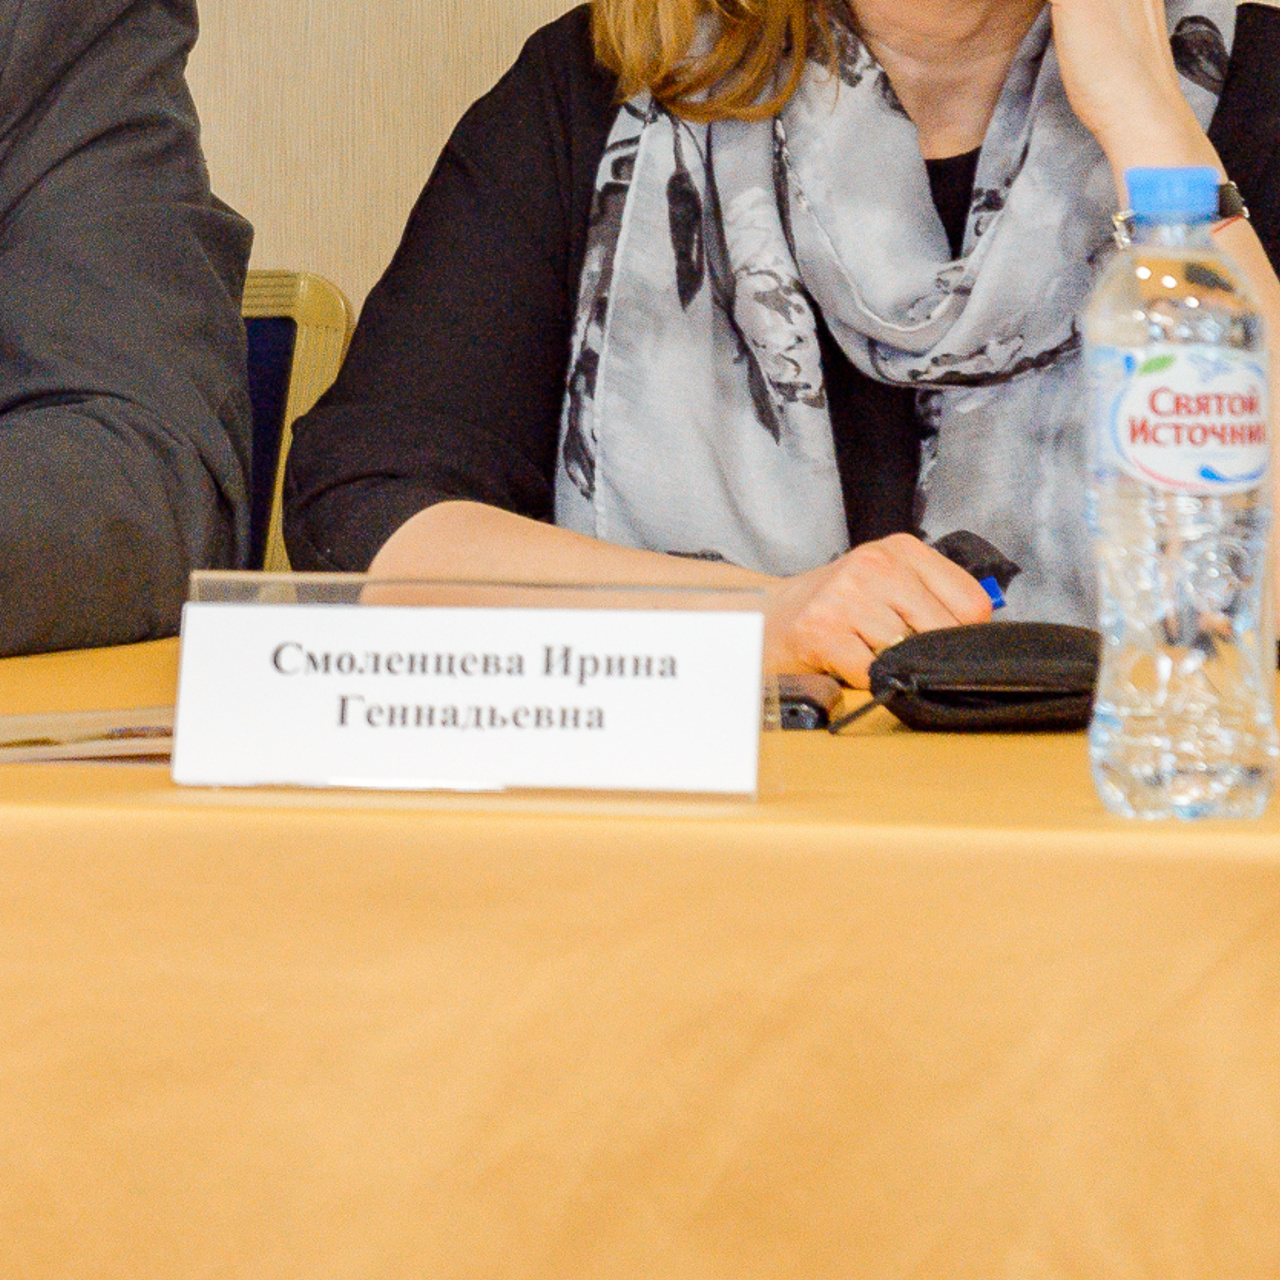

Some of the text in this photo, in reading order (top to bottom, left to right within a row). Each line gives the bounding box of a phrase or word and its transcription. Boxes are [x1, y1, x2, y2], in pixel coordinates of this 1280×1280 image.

[270, 641, 679, 686] Смоленцева Ирина
[337, 695, 606, 732] Геннадьевна
